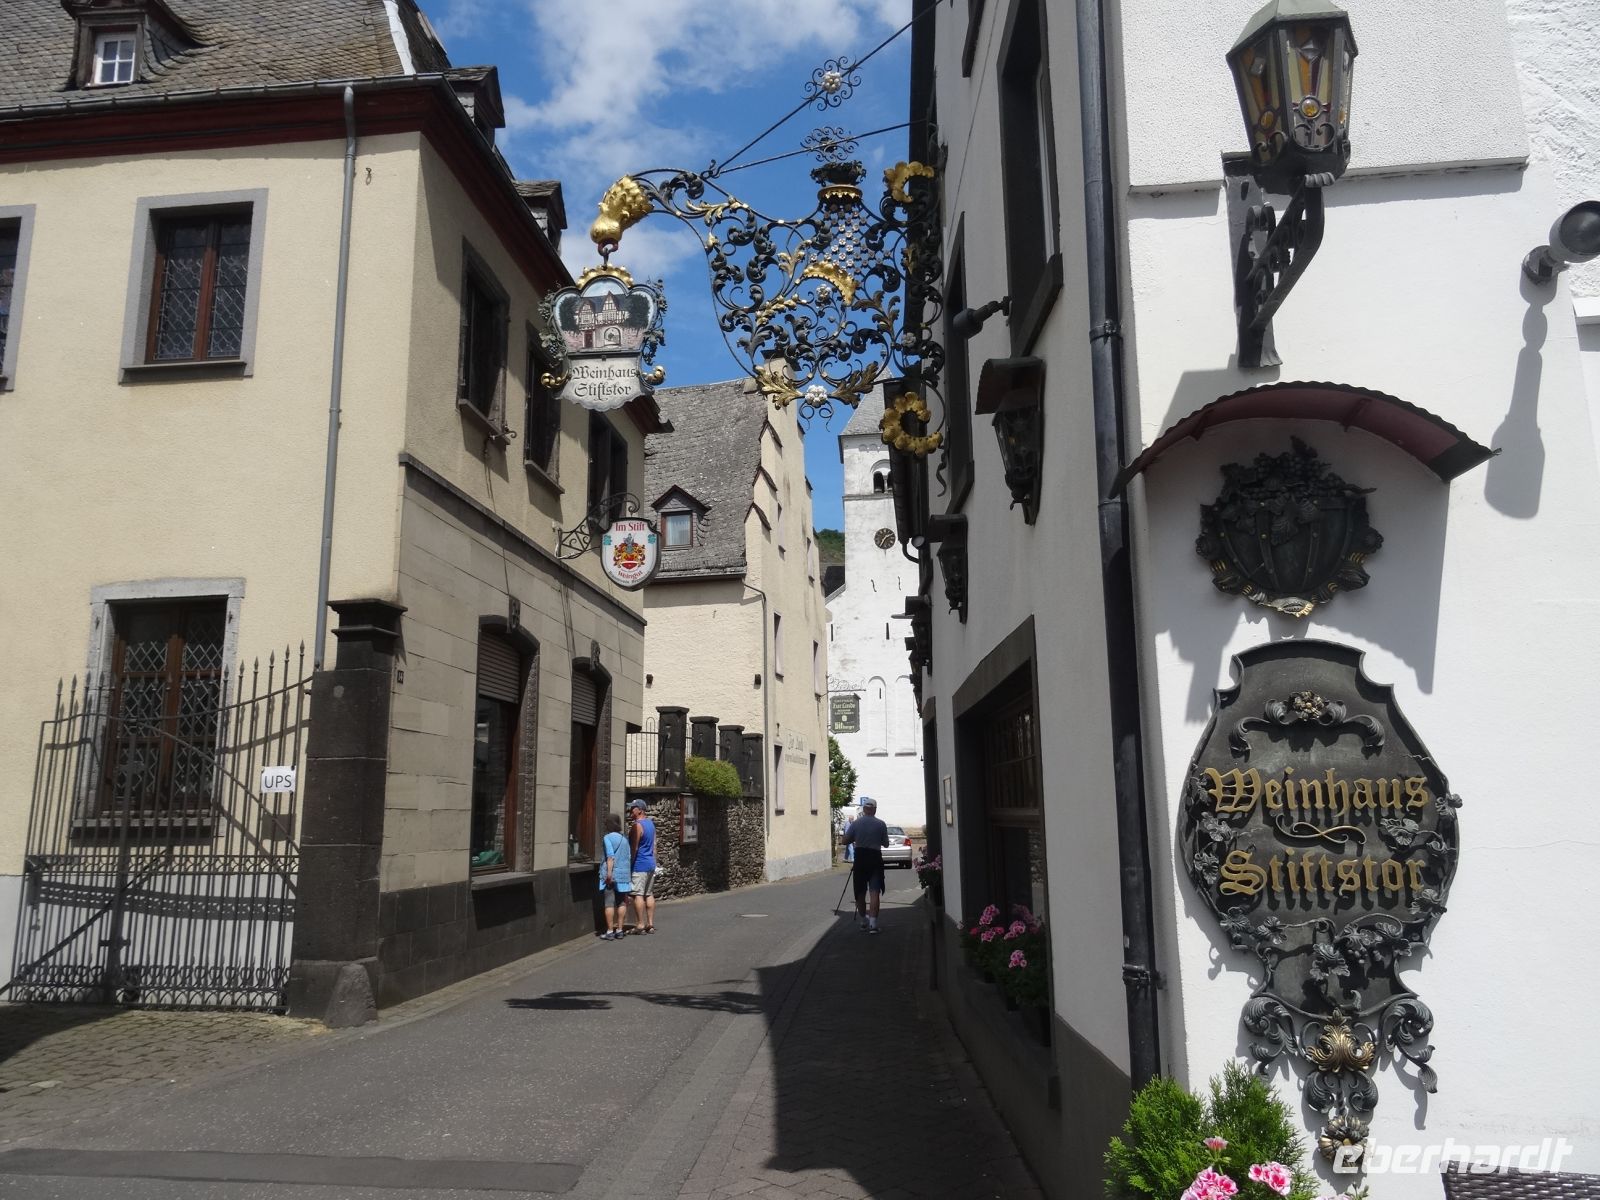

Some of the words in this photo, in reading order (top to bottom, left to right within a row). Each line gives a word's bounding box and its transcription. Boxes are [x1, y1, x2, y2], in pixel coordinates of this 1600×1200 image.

[572, 365, 638, 381] Weinhaus
[574, 383, 632, 400] Stiftstor
[615, 522, 627, 531] Im
[628, 521, 645, 531] Stift
[617, 570, 643, 580] Weingut
[264, 774, 292, 788] UPS
[1200, 766, 1430, 817] Weinhaus
[1220, 848, 1426, 896] Stiftstor
